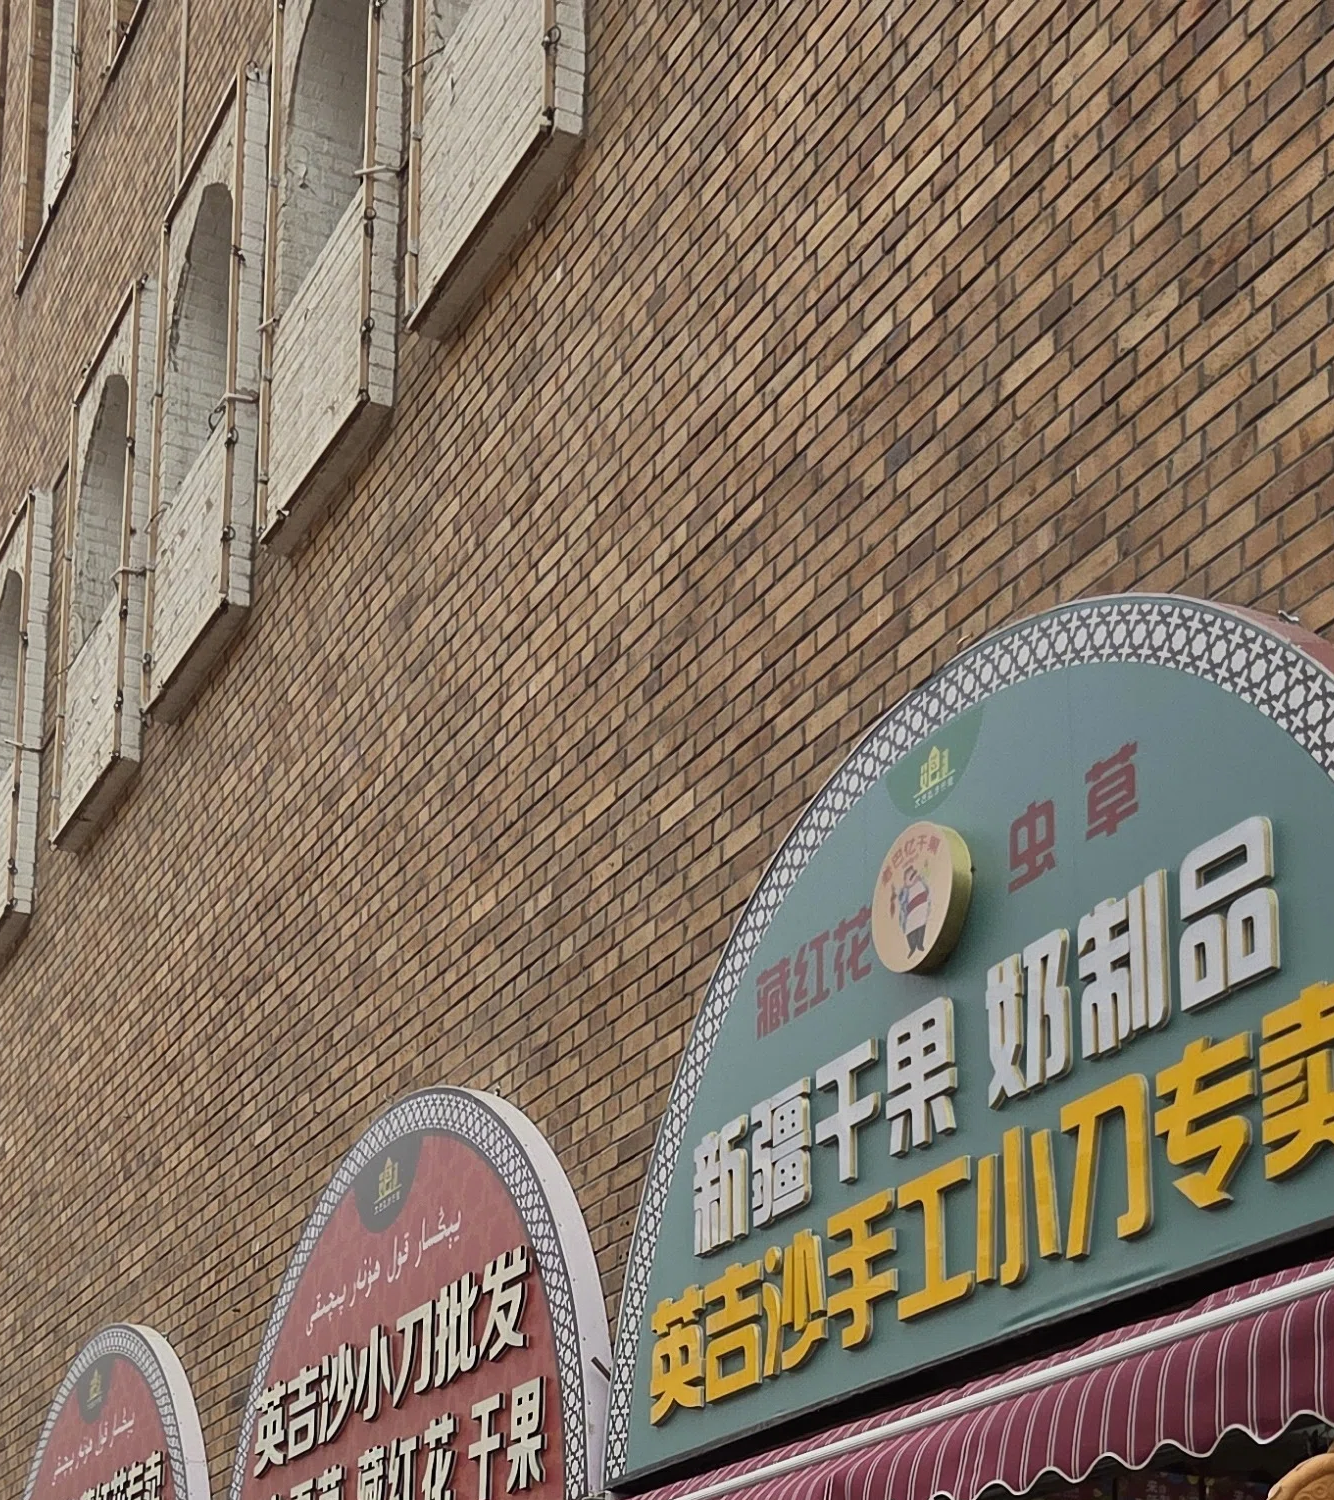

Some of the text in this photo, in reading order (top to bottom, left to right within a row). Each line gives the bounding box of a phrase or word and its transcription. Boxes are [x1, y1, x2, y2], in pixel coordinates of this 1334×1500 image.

[693, 815, 1280, 1258] 新疆干果 奶制品
[757, 905, 872, 1041] 藏红花
[253, 1246, 530, 1478] 英吉沙小刀批发
